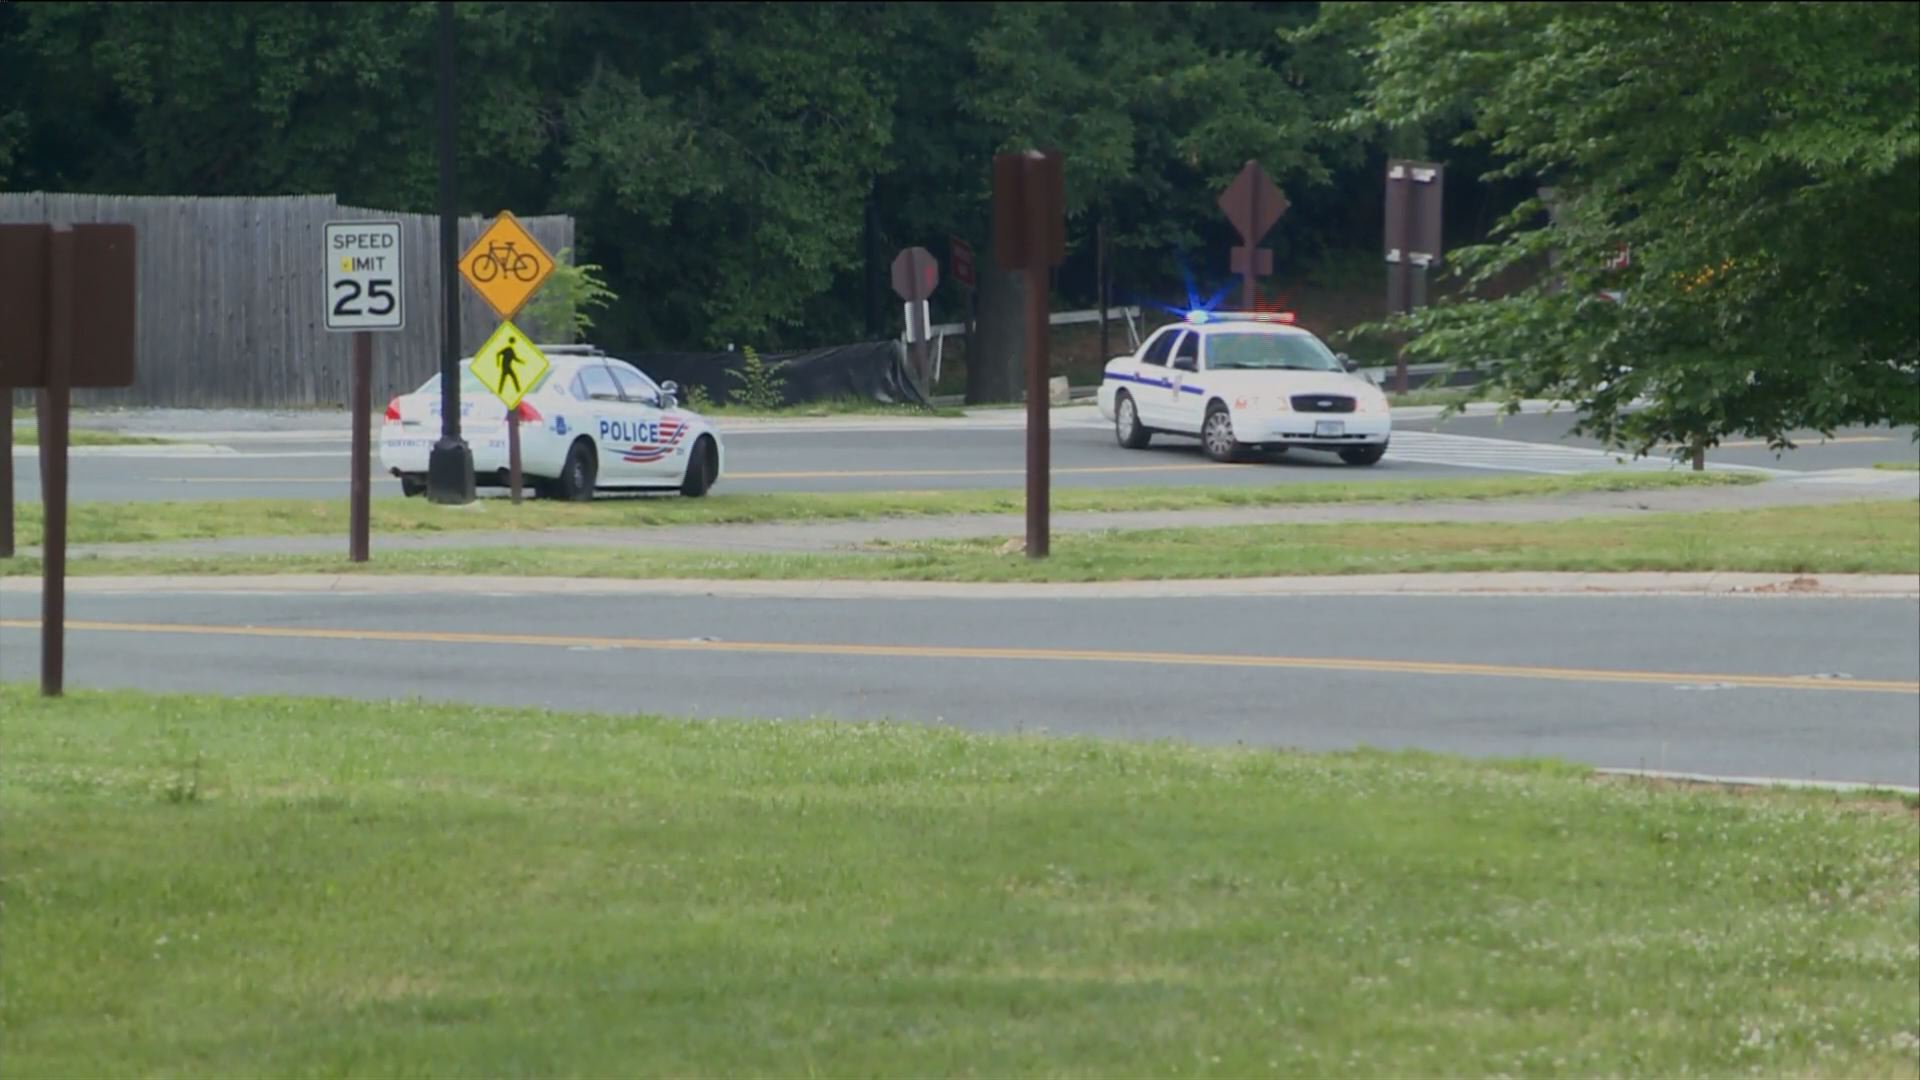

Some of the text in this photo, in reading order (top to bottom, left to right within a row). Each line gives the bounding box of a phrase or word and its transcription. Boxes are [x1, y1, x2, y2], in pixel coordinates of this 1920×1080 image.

[333, 233, 393, 249] SPEED
[342, 256, 386, 272] IMIT
[333, 279, 395, 316] 25
[600, 420, 658, 443] POLICE
